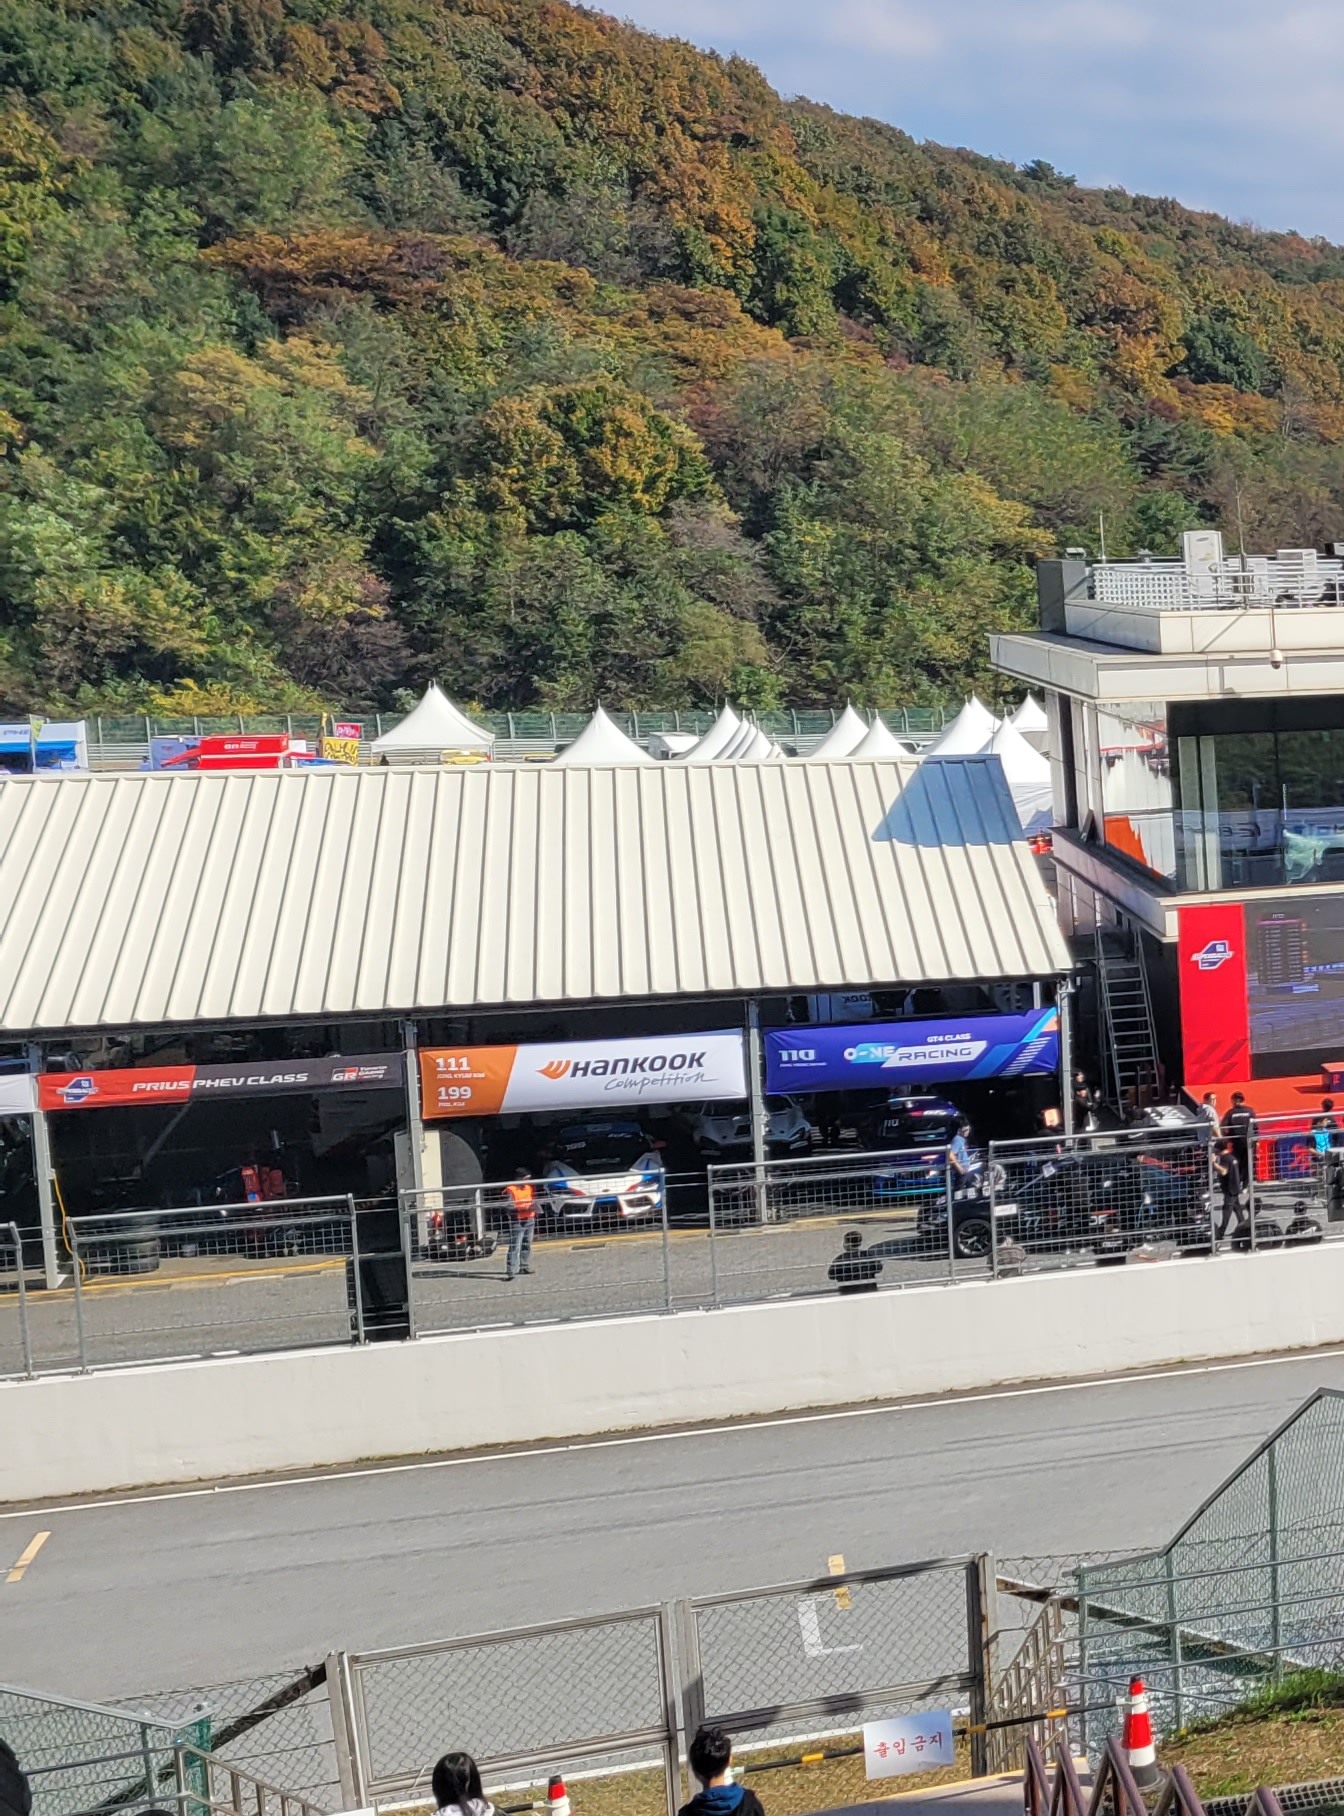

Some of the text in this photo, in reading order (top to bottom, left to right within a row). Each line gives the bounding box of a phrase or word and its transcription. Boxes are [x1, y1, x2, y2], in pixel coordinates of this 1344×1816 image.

[945, 1033, 971, 1042] CLASS
[778, 1049, 816, 1061] 110
[898, 1047, 972, 1061] RACING
[435, 1057, 471, 1071] 111
[132, 1072, 309, 1093] PRIUS PHEV CLASS
[331, 1072, 357, 1081] GR
[604, 1072, 718, 1094] Competition
[437, 1086, 472, 1100] 199
[872, 1731, 943, 1758] 출입 금지
